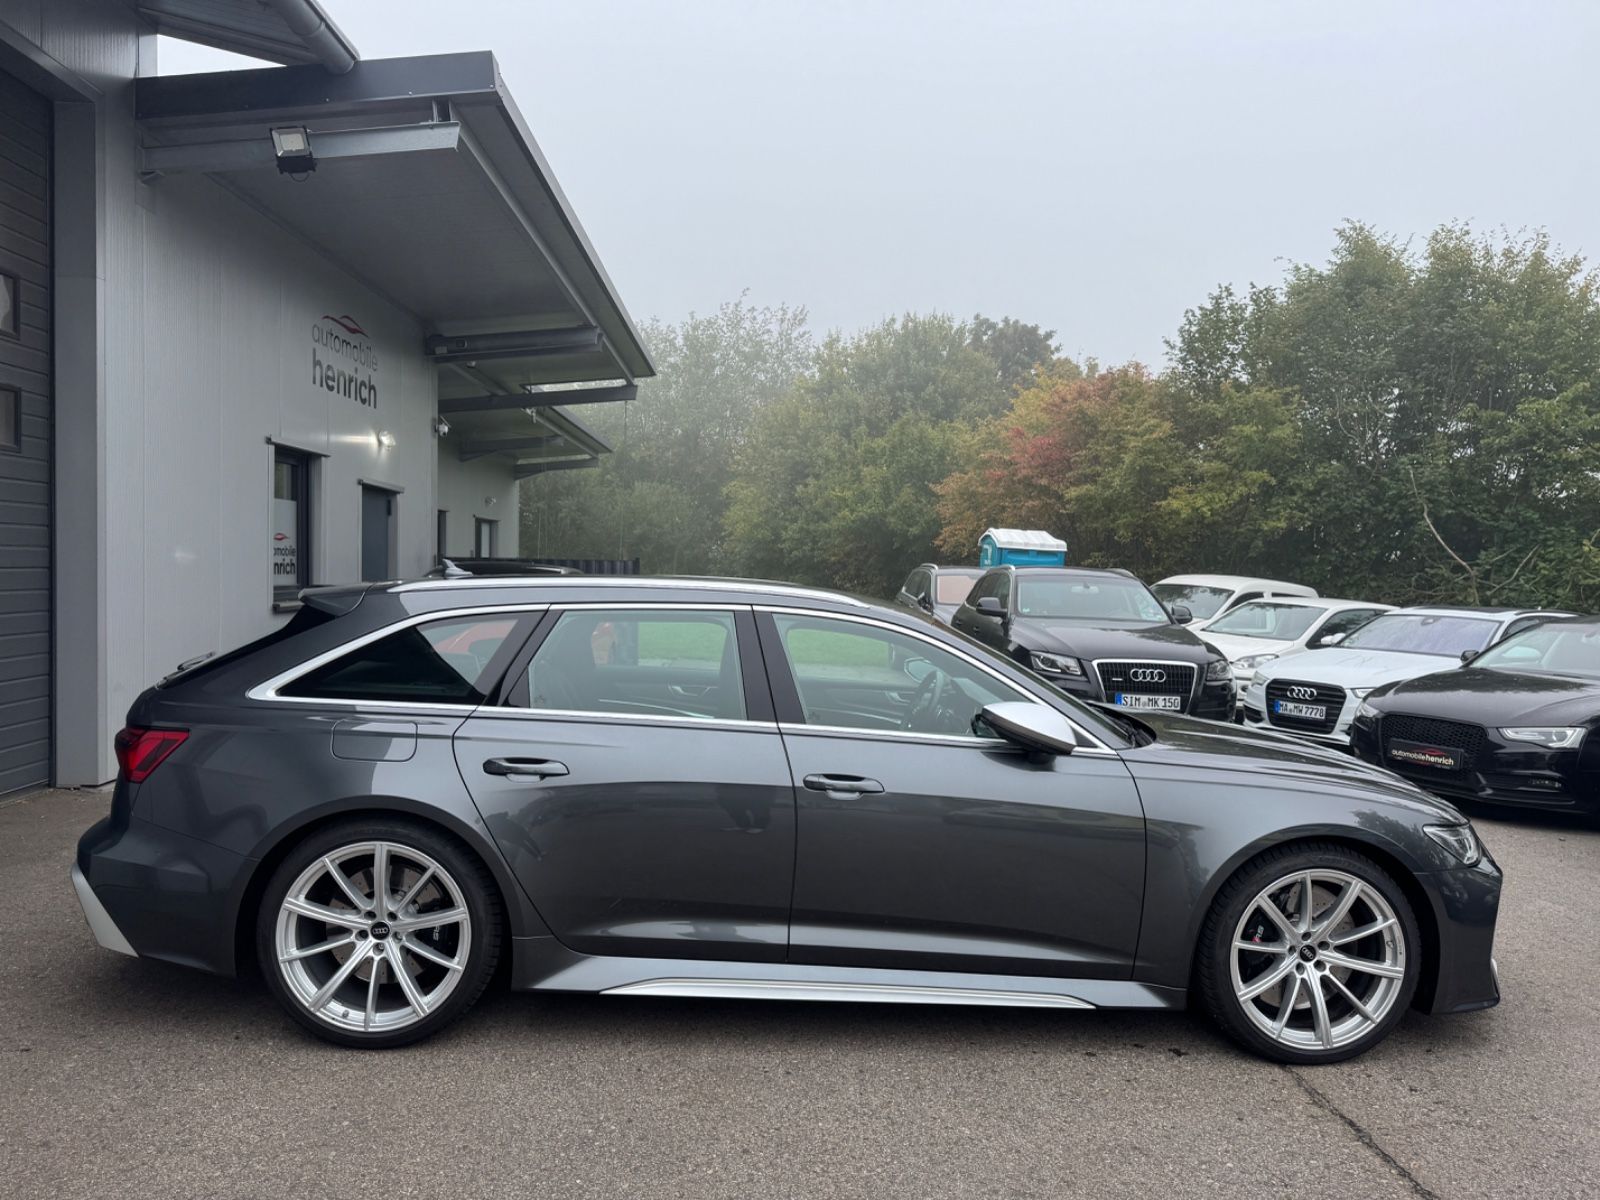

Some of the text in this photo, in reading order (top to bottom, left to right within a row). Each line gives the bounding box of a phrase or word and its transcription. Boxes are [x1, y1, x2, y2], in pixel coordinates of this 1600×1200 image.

[312, 324, 378, 371] automobile
[312, 347, 377, 409] henrich
[1122, 696, 1180, 709] SIM MK 150
